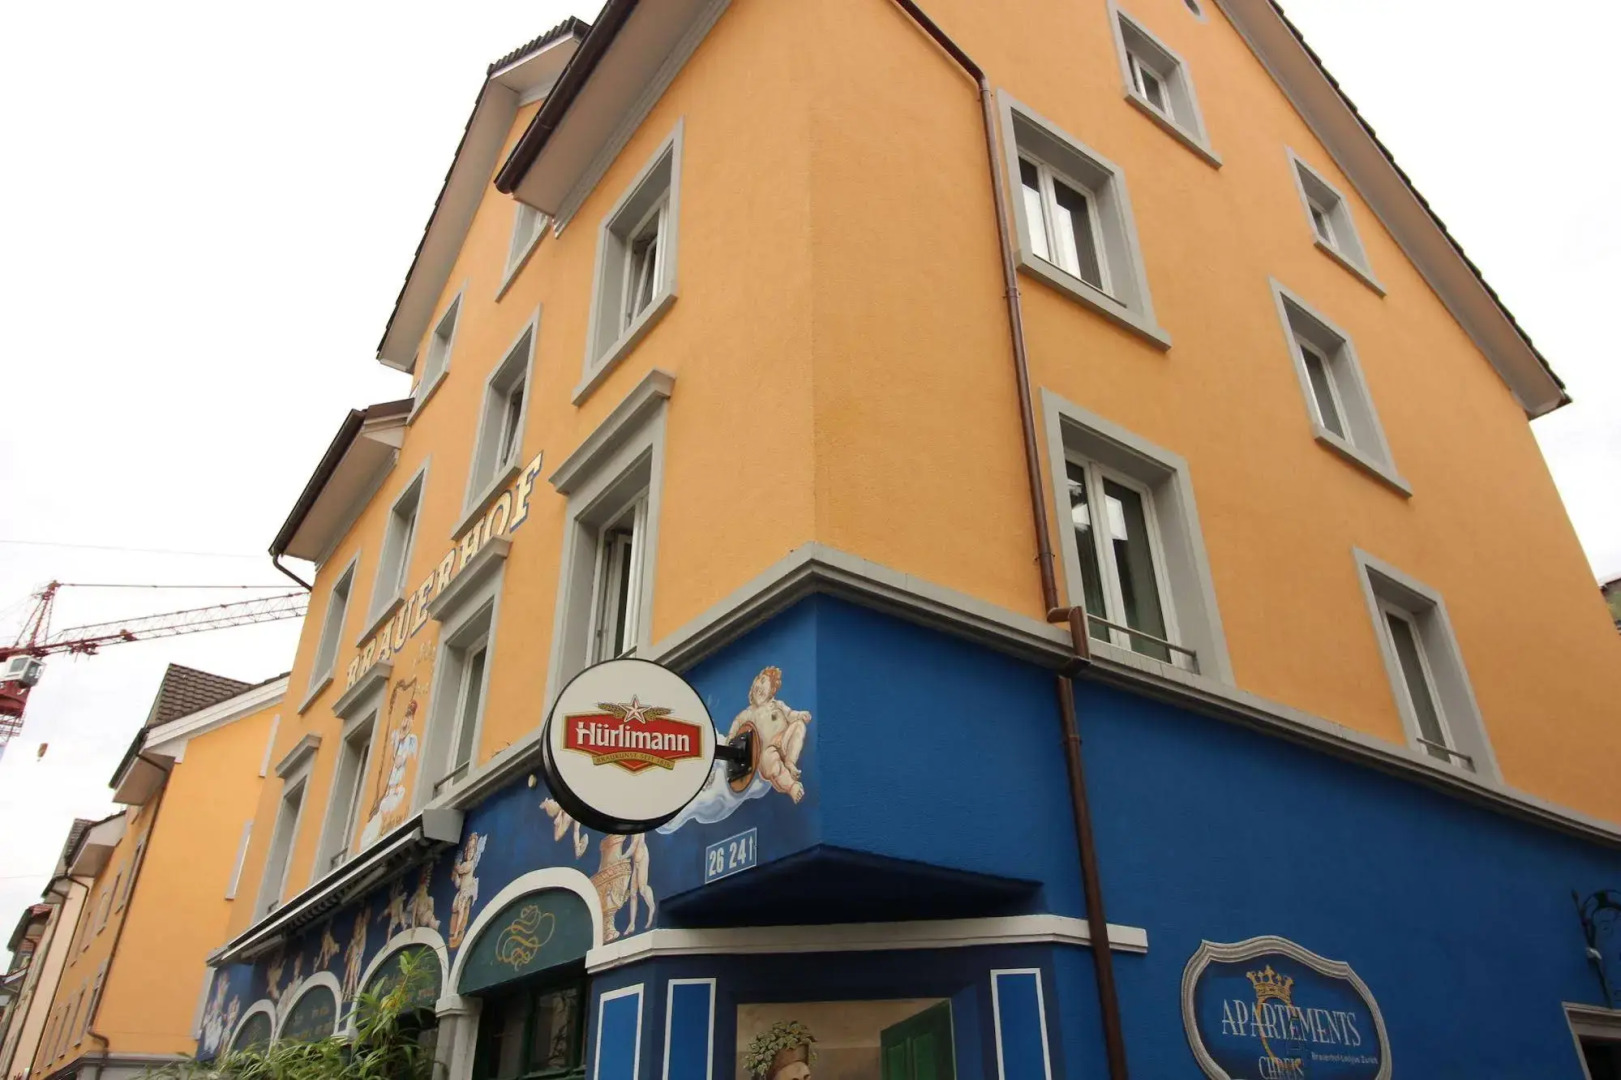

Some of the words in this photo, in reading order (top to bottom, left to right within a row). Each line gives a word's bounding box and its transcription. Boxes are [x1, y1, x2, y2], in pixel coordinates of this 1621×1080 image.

[347, 450, 544, 691] BRAUERHOF
[575, 721, 690, 752] Hürlimann
[708, 847, 725, 876] 26
[729, 838, 747, 869] 24
[1221, 999, 1361, 1047] APARTEMENTS
